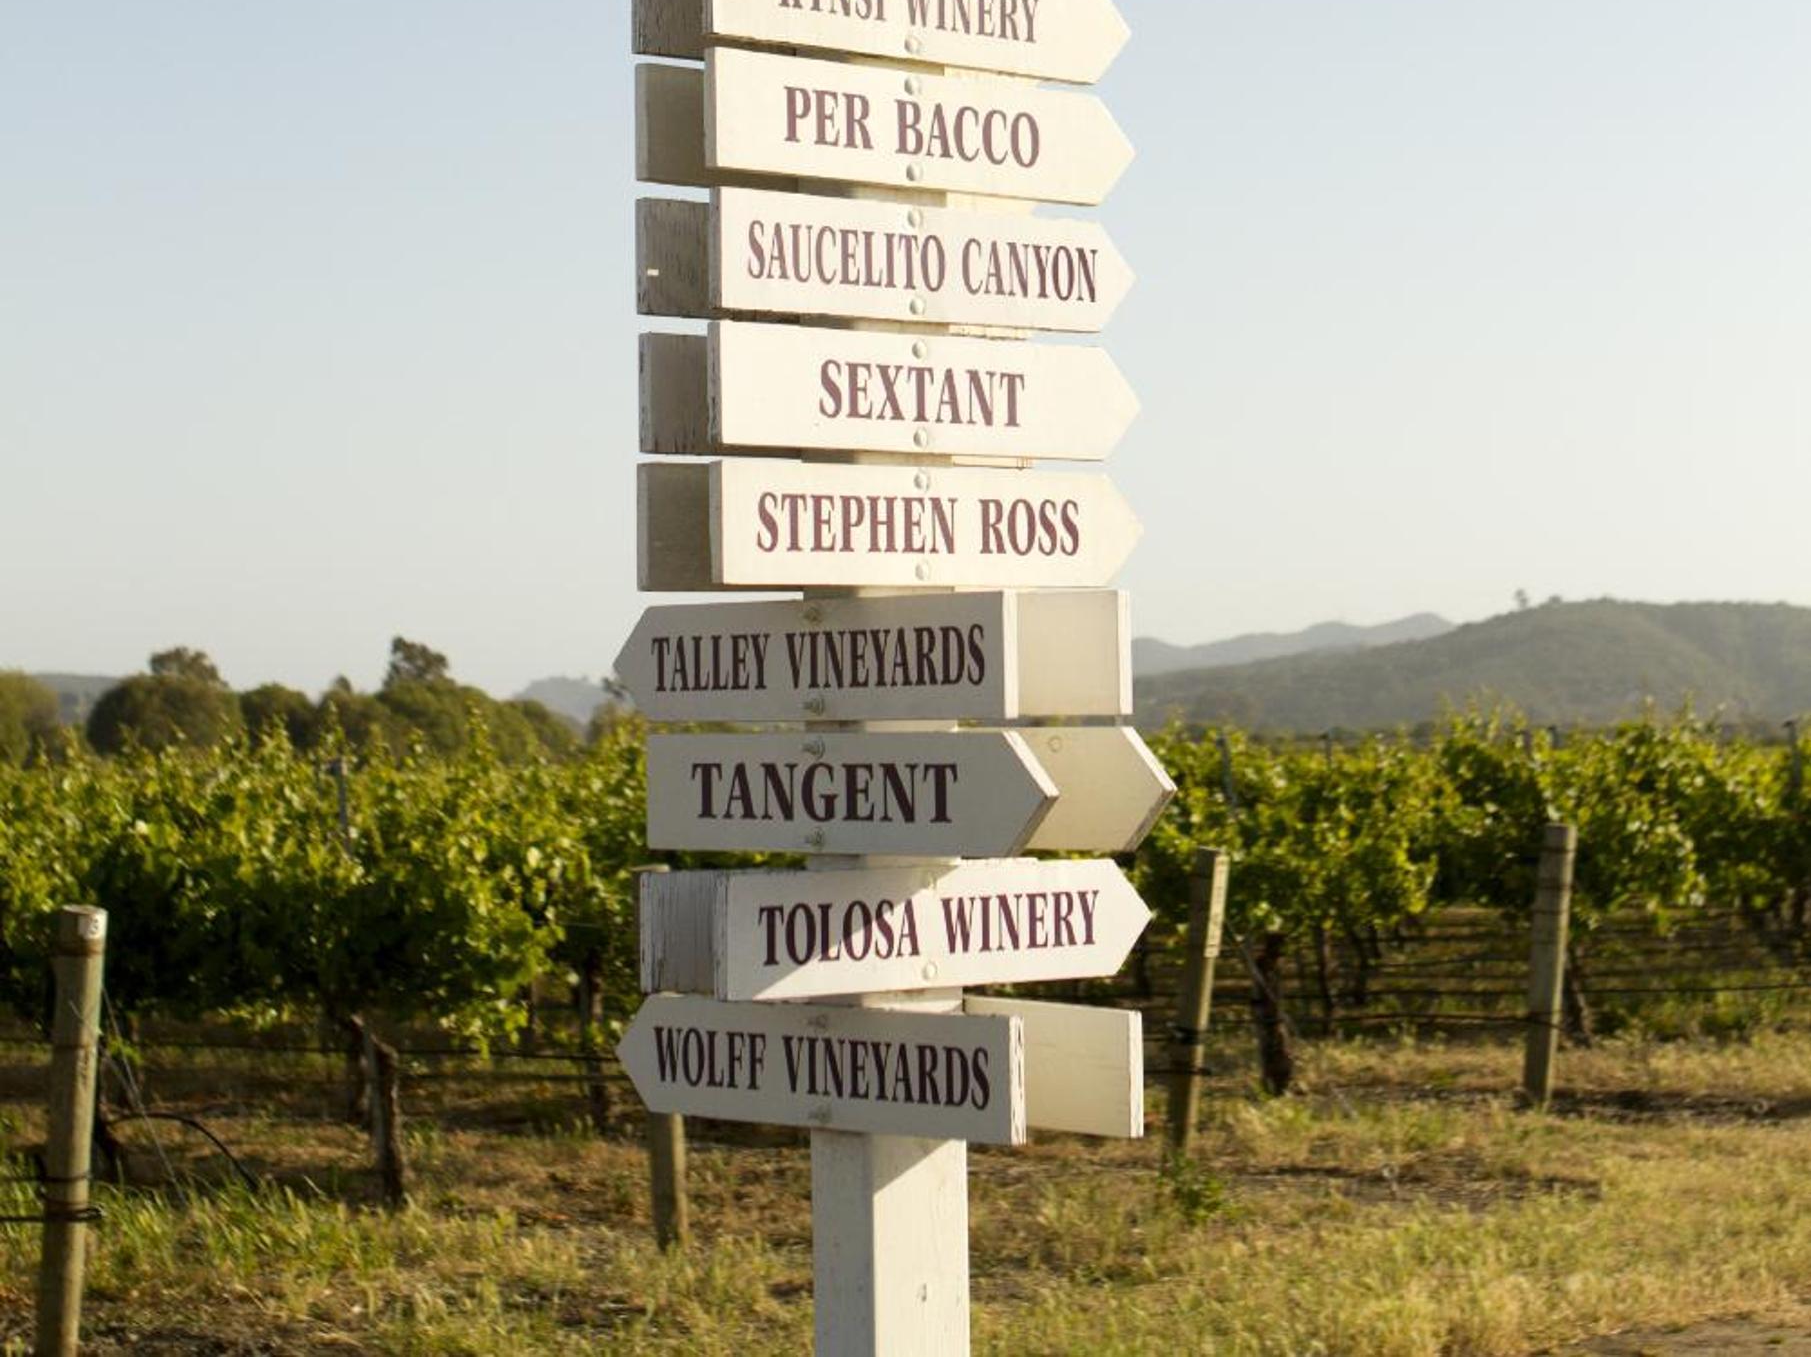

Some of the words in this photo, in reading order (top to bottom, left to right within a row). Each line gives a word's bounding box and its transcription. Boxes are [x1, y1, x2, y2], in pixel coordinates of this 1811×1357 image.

[783, 85, 874, 150] PER
[893, 97, 1041, 169] BACCO
[746, 219, 946, 293] SAUCELITO
[961, 237, 1098, 303] CANYON
[818, 358, 1025, 428] SEXTANT
[756, 491, 958, 555] STEPHEN
[978, 497, 1080, 557] ROSS
[651, 632, 771, 692] TALLEY
[785, 623, 986, 691] VINEYARDS
[691, 761, 958, 824] TANGENT
[758, 898, 921, 967] TOLOSA
[940, 889, 1100, 955] WINERY
[653, 1025, 767, 1092] WOLFF
[782, 1034, 990, 1111] VINEYARDS
